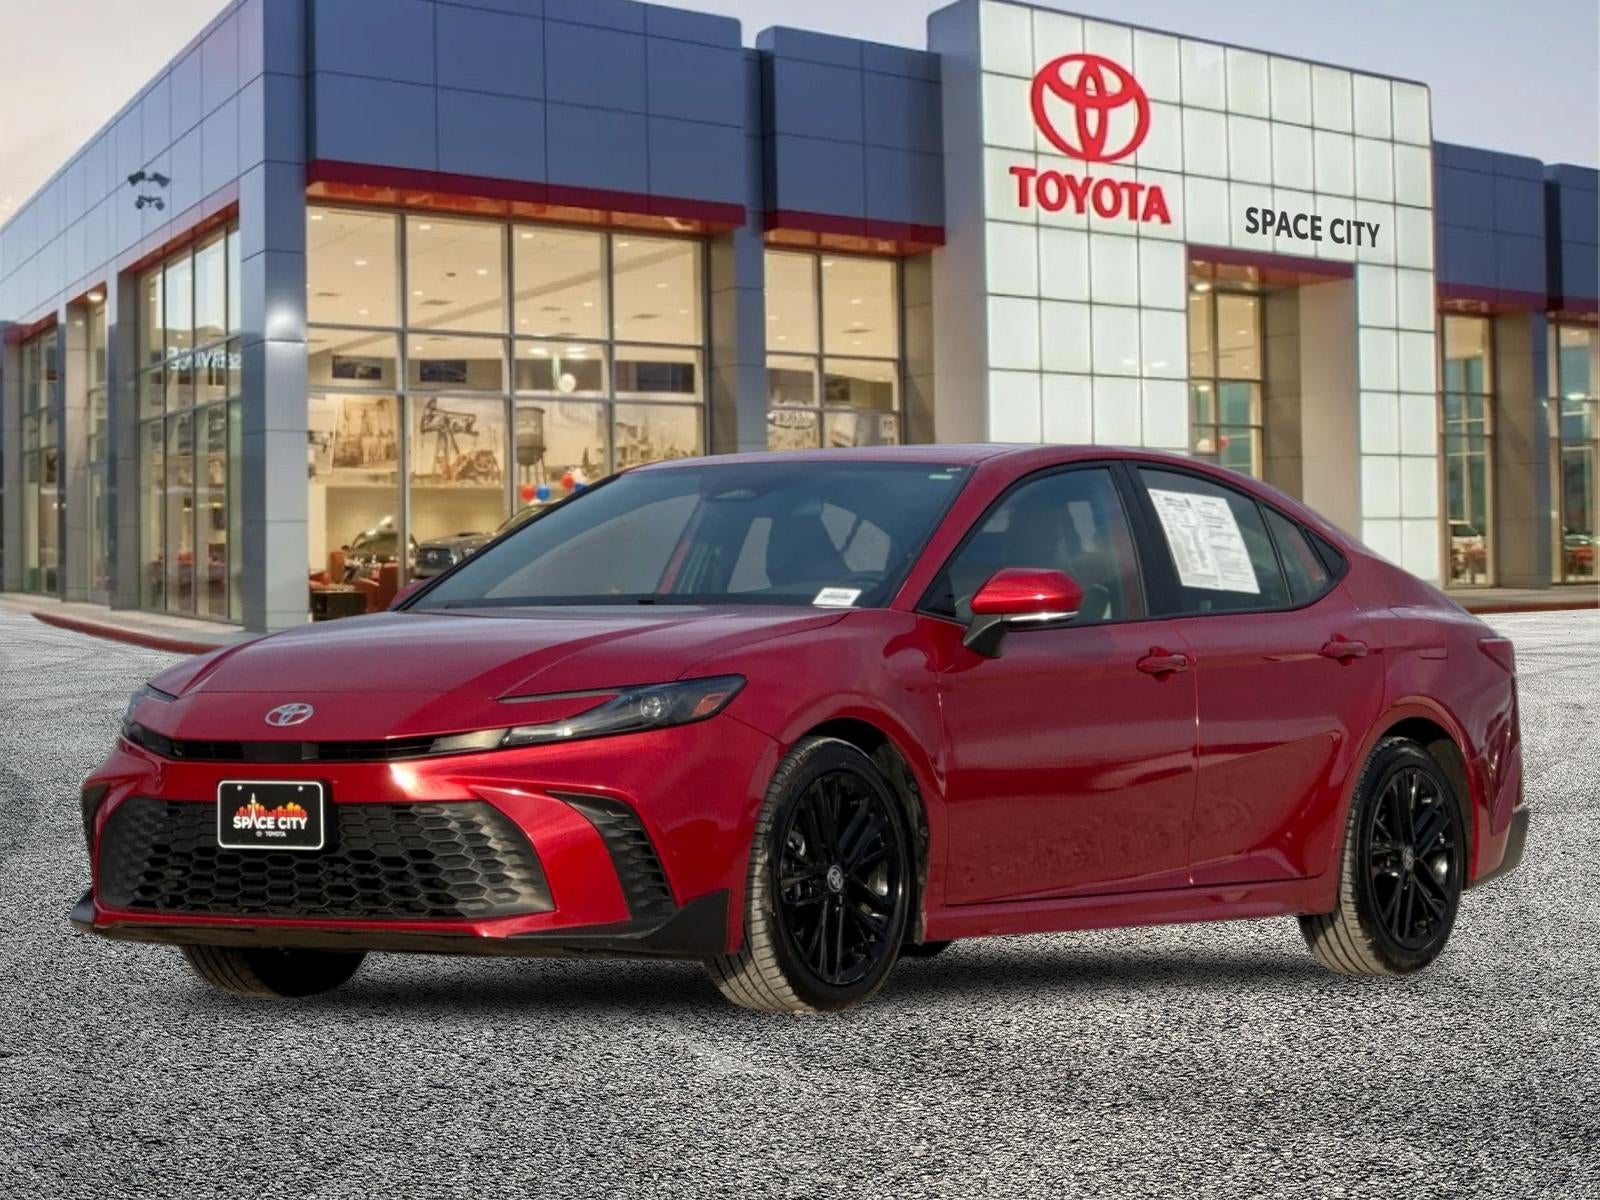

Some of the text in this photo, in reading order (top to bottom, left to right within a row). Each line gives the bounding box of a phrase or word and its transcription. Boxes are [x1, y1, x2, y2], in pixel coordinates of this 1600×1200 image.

[1009, 166, 1171, 224] TOYOTA
[1246, 206, 1381, 248] SPACE CITY
[233, 815, 308, 830] SPACE CITY
[264, 830, 287, 838] TOYOTA
